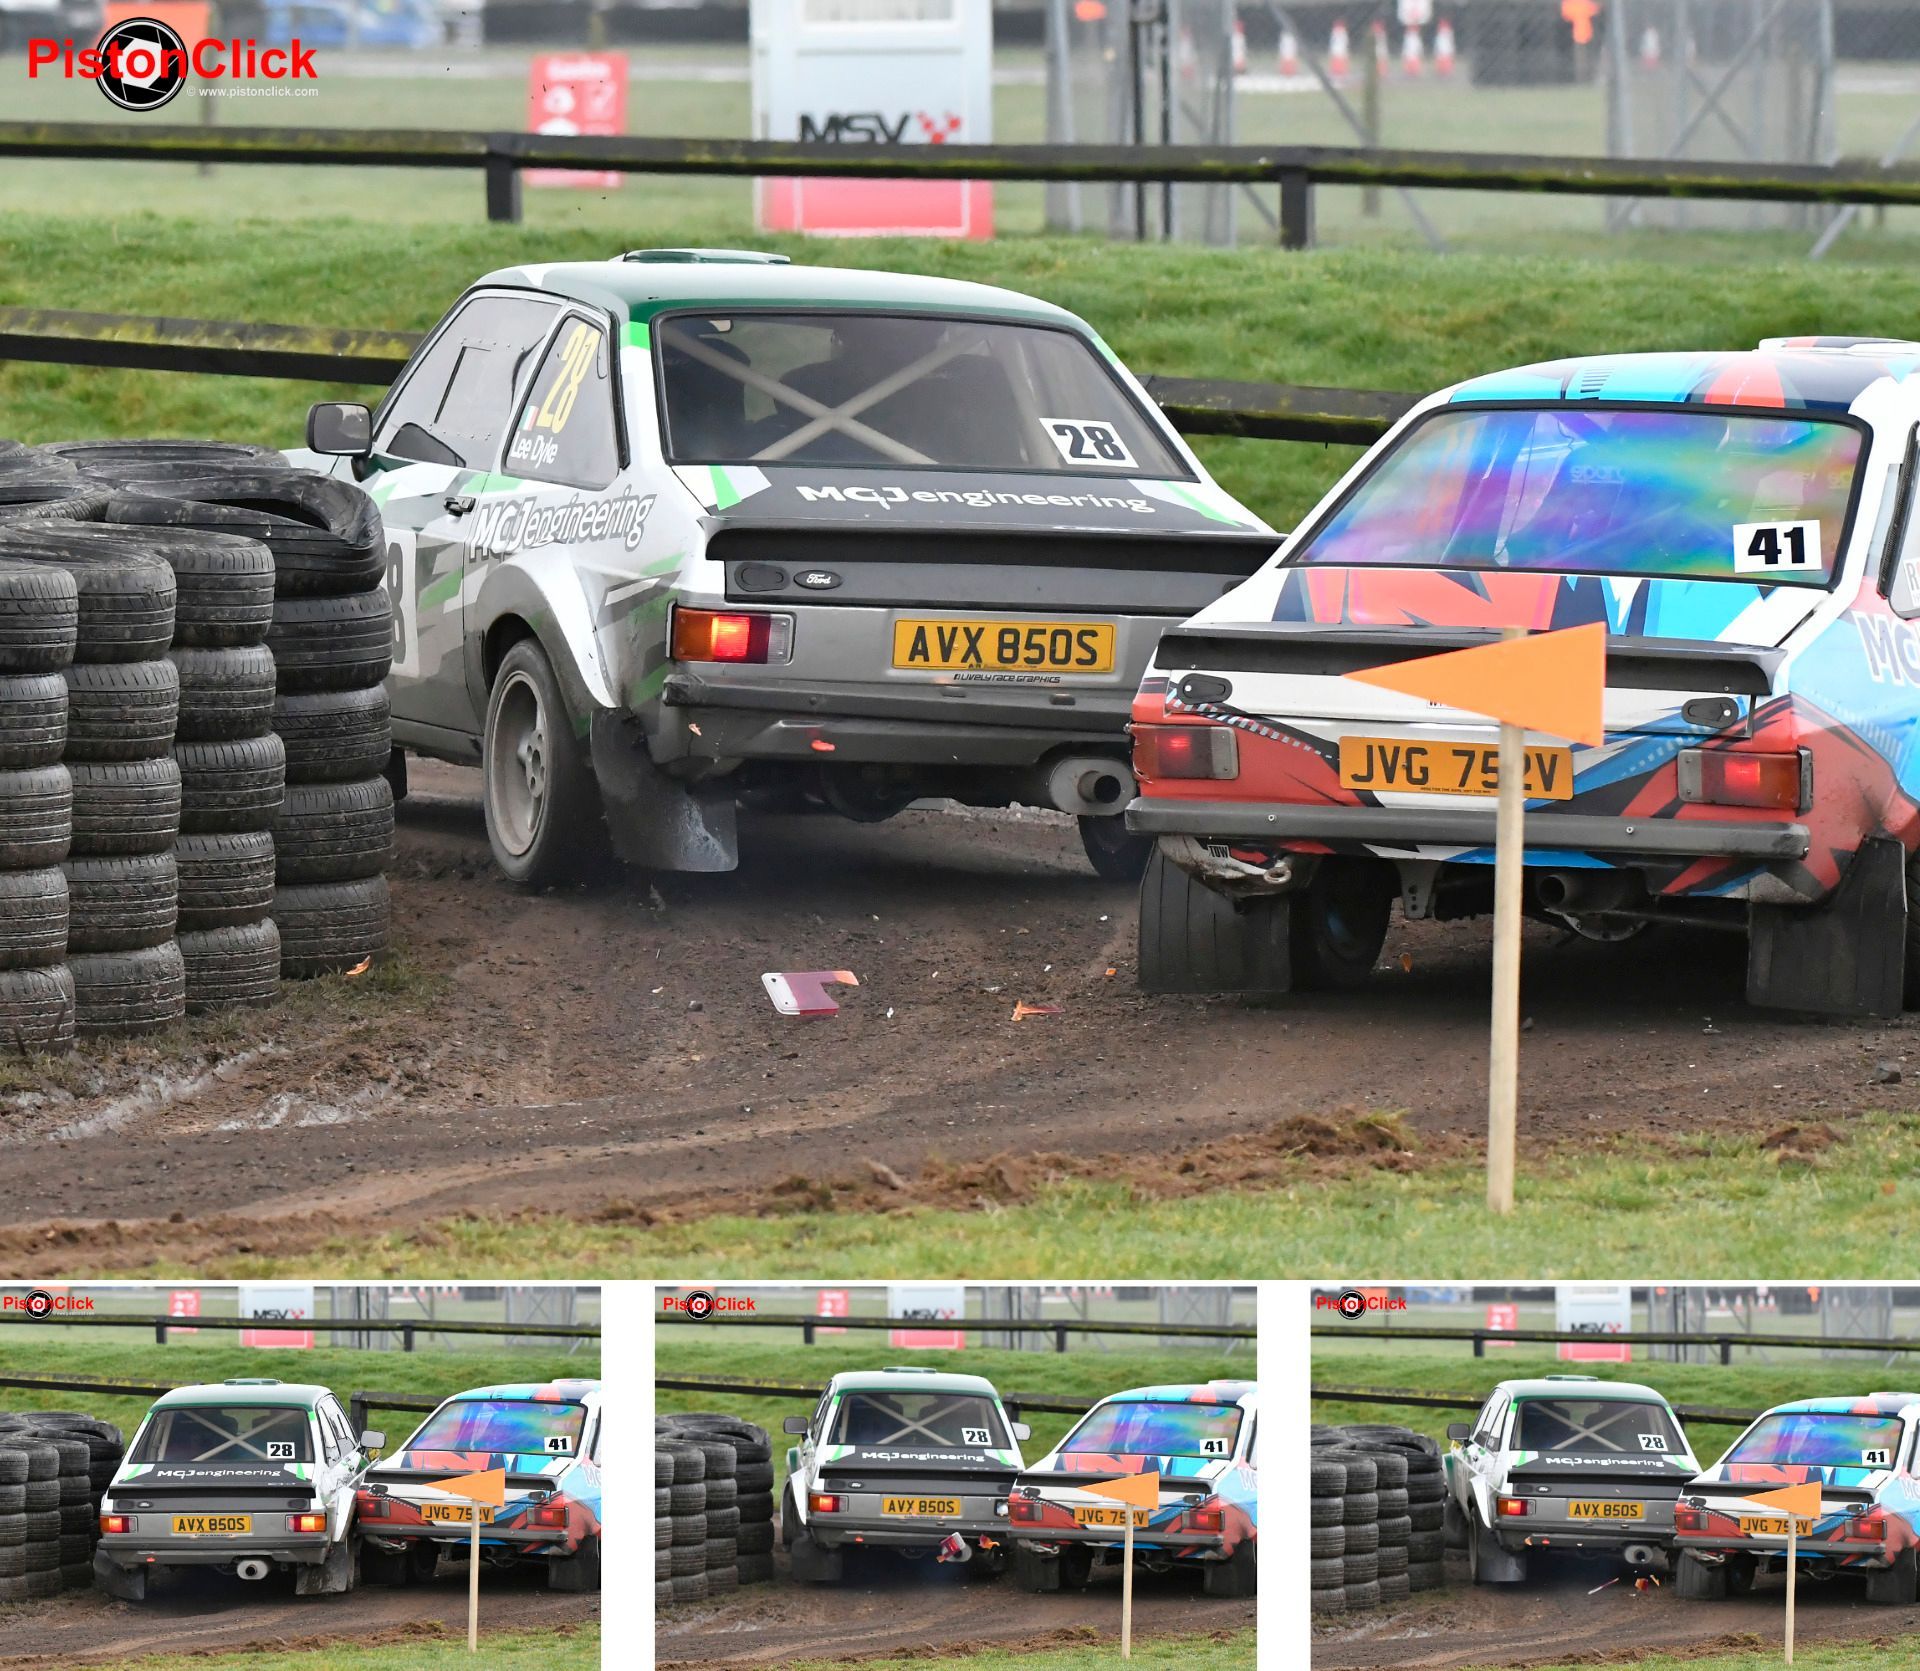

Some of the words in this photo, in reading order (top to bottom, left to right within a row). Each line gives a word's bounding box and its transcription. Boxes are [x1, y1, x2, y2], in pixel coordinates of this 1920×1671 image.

[800, 113, 909, 144] MSV
[536, 323, 602, 434] 28
[510, 430, 532, 459] Lee
[530, 435, 558, 469] Dyke
[1052, 424, 1127, 461] 28
[1747, 526, 1806, 565] 41
[806, 573, 832, 584] Ford
[908, 625, 985, 664] AVX
[996, 628, 1099, 666] 850S
[1350, 744, 1430, 786] JVG
[1209, 846, 1229, 858] TOW
[253, 1309, 289, 1320] MSV
[903, 1309, 938, 1319] MSV
[1571, 1322, 1606, 1333] MSV
[965, 1430, 989, 1443] 28
[1642, 1436, 1665, 1449] 28
[270, 1443, 293, 1457] 28
[549, 1437, 568, 1451] 41
[1204, 1440, 1223, 1453] 41
[1866, 1451, 1885, 1463] 41
[425, 1505, 450, 1519] JVG
[456, 1507, 490, 1521] 75V
[888, 1499, 915, 1513] AVX
[918, 1500, 955, 1514] 850S
[1574, 1503, 1600, 1517] AVX
[1603, 1504, 1638, 1517] 850S
[1078, 1509, 1104, 1523] JVG
[178, 1518, 205, 1532] AVX
[208, 1517, 245, 1531] 850S
[1743, 1518, 1768, 1532] JVG
